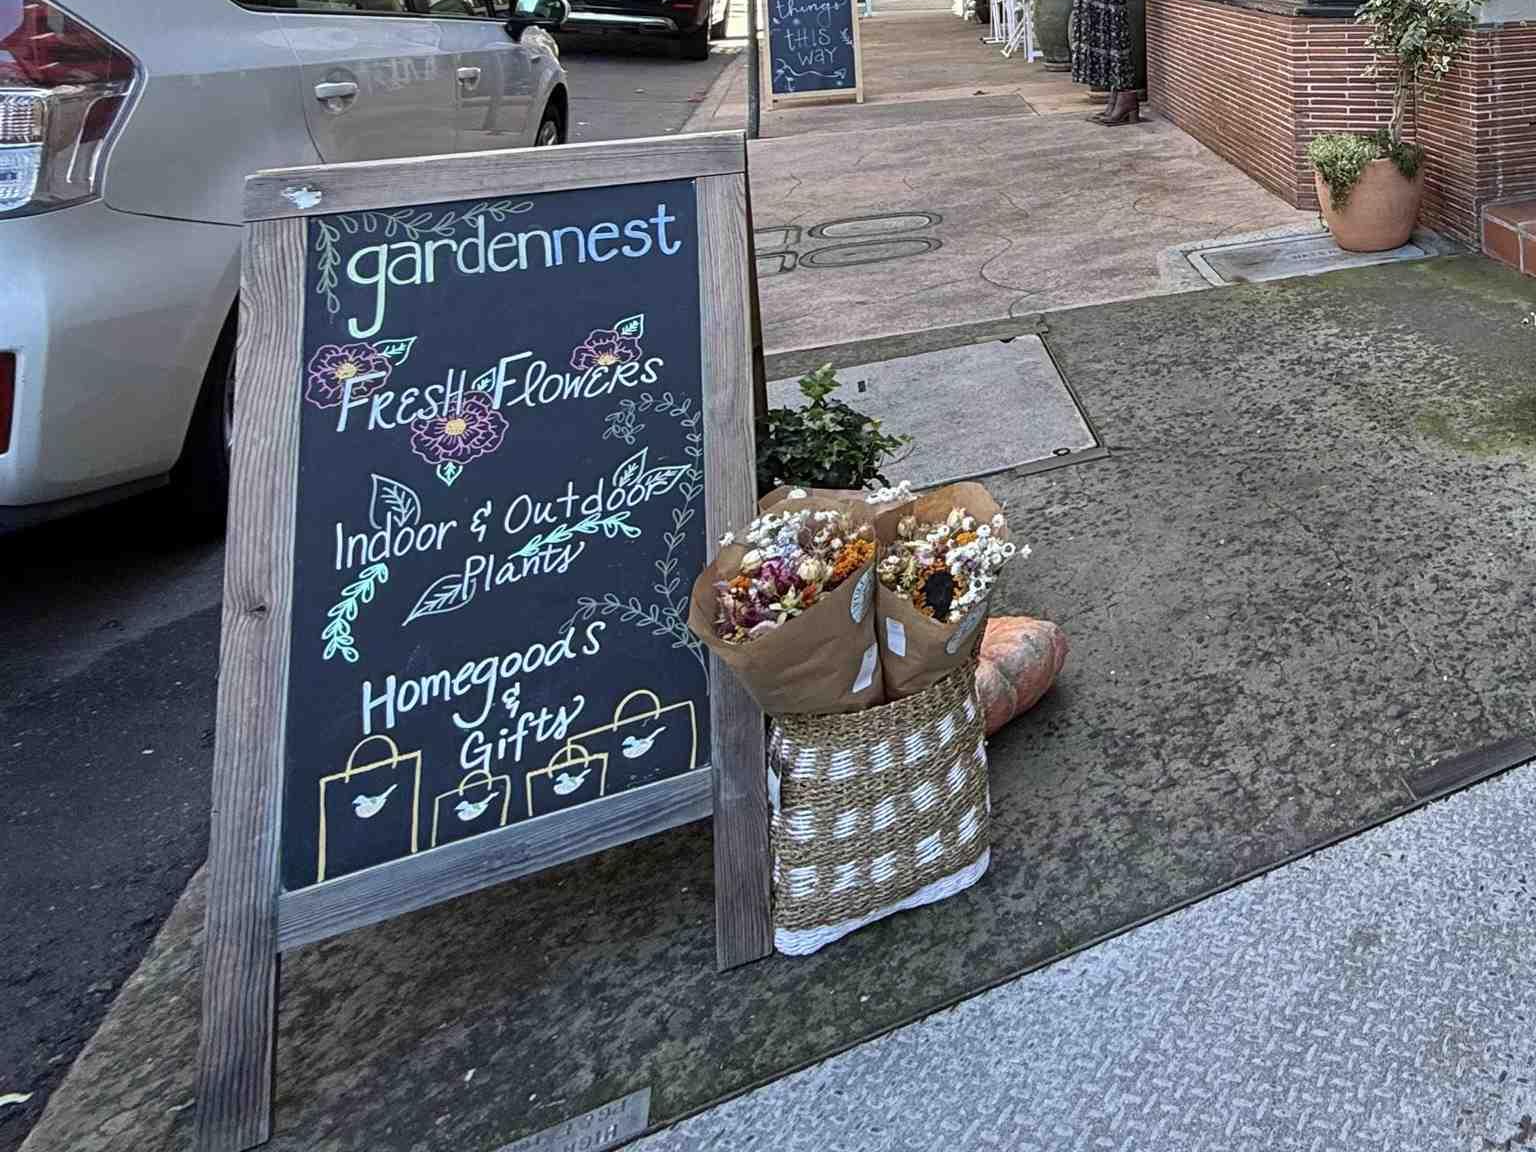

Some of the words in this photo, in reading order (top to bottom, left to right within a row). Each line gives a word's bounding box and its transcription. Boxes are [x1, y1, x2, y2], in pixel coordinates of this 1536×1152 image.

[346, 203, 682, 340] gardennest
[336, 367, 466, 432] FRESH
[335, 512, 457, 571] Indoor
[470, 501, 492, 542] &
[504, 478, 668, 534] Outdoor
[461, 540, 587, 601] Plants
[459, 694, 585, 773] Gifts
